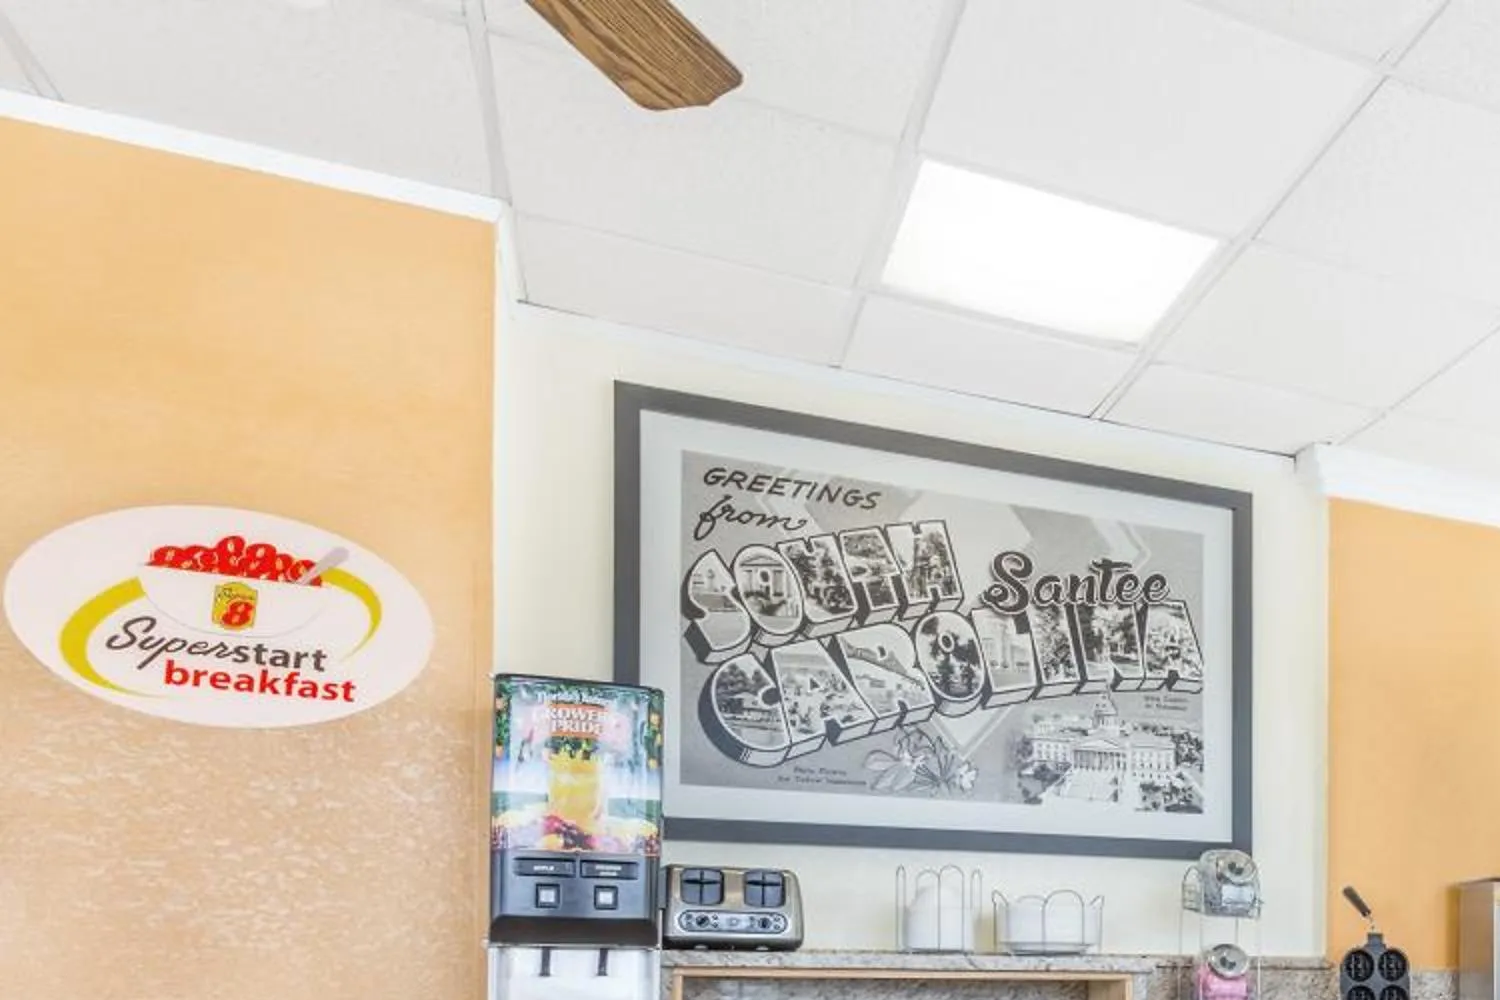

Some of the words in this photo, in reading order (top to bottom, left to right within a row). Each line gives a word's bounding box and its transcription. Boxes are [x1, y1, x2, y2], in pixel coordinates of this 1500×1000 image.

[702, 466, 884, 511] GREETINGS
[693, 495, 808, 541] from
[683, 519, 965, 665] SOUTH
[980, 551, 1169, 615] Santee
[221, 600, 254, 626] 8
[105, 616, 329, 671] Superstart
[164, 660, 357, 702] breakfast
[698, 599, 1205, 768] CAROLINA
